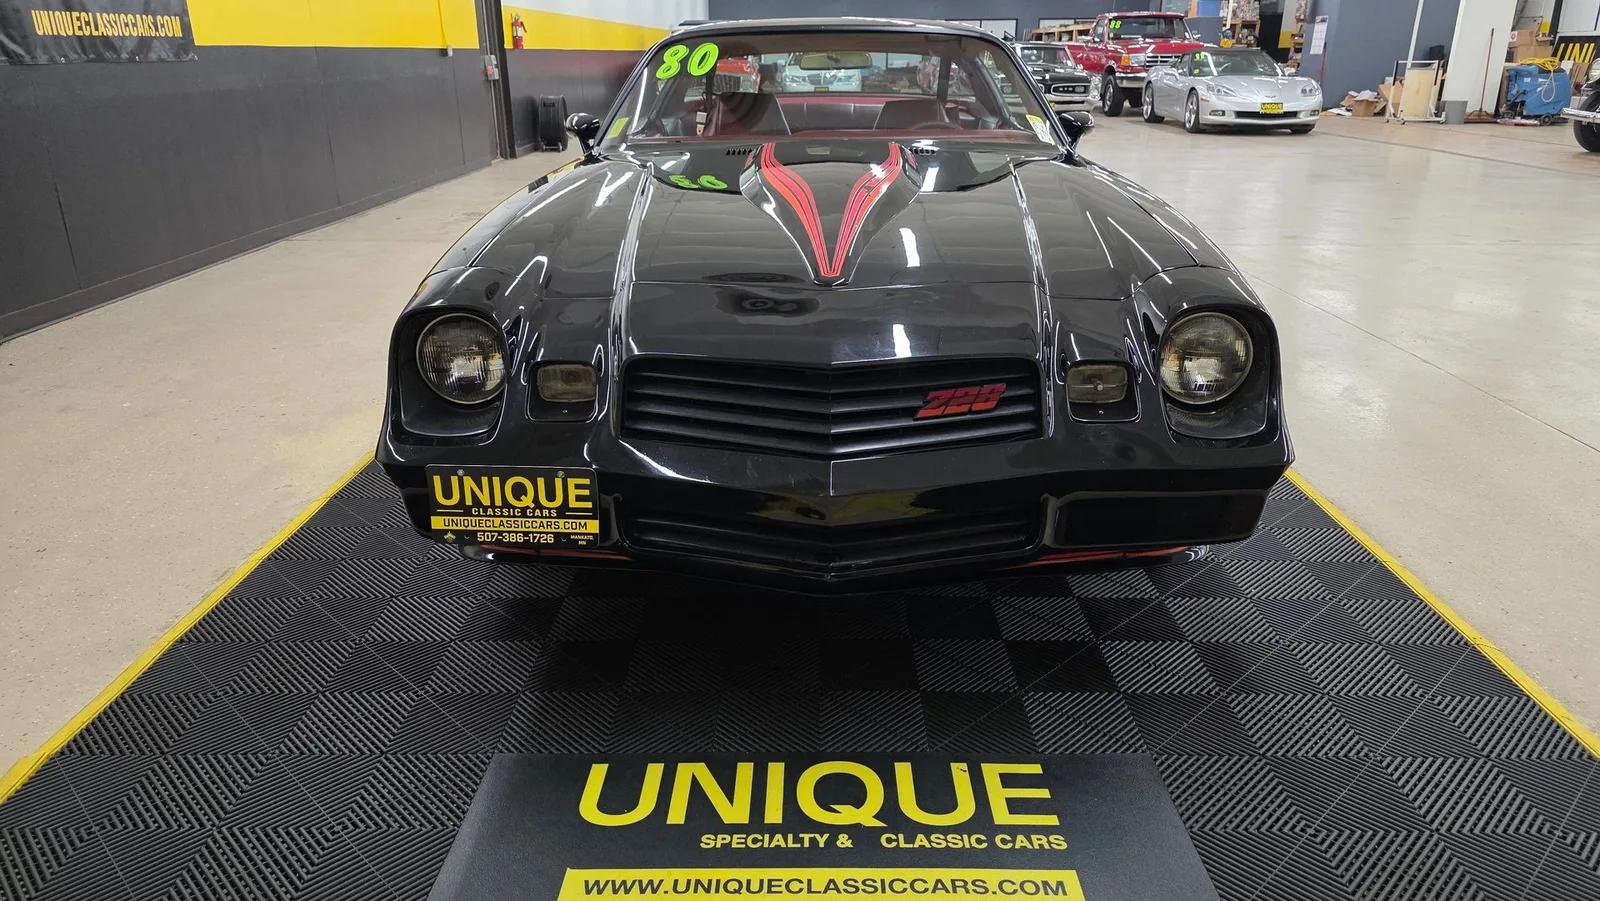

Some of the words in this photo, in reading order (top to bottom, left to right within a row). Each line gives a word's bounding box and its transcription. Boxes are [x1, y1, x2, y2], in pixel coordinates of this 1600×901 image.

[31, 10, 182, 37] UNIQUECLASSICCARS.COM
[656, 42, 720, 79] 80
[914, 383, 1007, 419] Z28
[433, 475, 593, 509] UNIQUE
[443, 517, 588, 530] UNIQUECLASSICCARS.COM
[472, 507, 522, 517] CLASSIC
[526, 508, 558, 517] CARS
[477, 532, 555, 544] 507-386-1726
[578, 761, 1061, 828] UNIQUE
[699, 833, 830, 849] SPECIALTY
[836, 833, 853, 849] &
[880, 833, 988, 849] CLASSIC
[994, 833, 1068, 850] CARS
[583, 878, 1068, 897] WWW.UNIQUECLASSICCARS.COM
